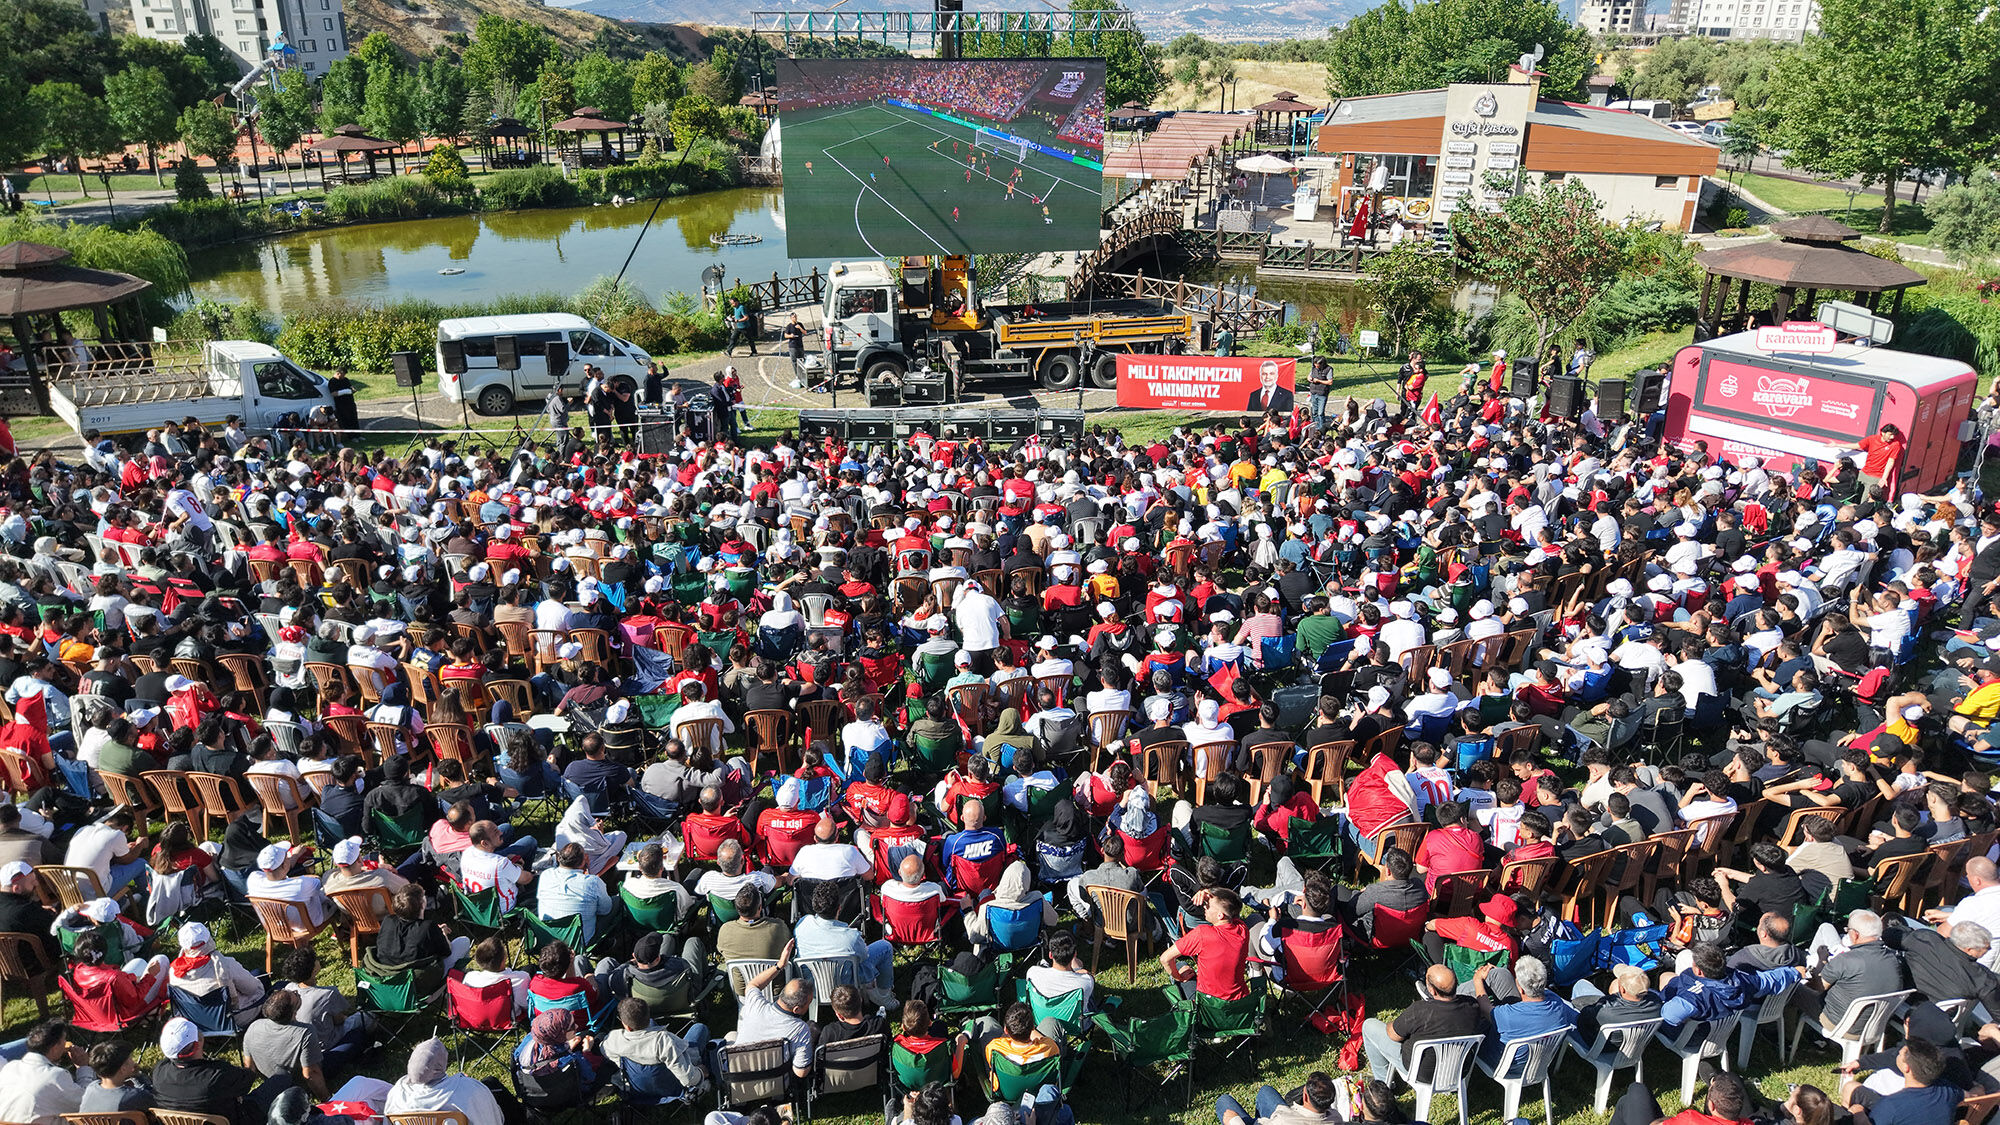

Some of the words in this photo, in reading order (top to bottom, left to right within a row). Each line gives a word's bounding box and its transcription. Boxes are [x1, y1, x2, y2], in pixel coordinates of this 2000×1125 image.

[1483, 122, 1516, 135] Bistro
[1161, 365, 1242, 383] TAKIMIMIZIN
[1147, 382, 1220, 398] YANINDAYIZ
[91, 416, 111, 424] 2011
[187, 496, 202, 514] 8
[1420, 779, 1450, 806] 10
[962, 840, 994, 859] NIKE
